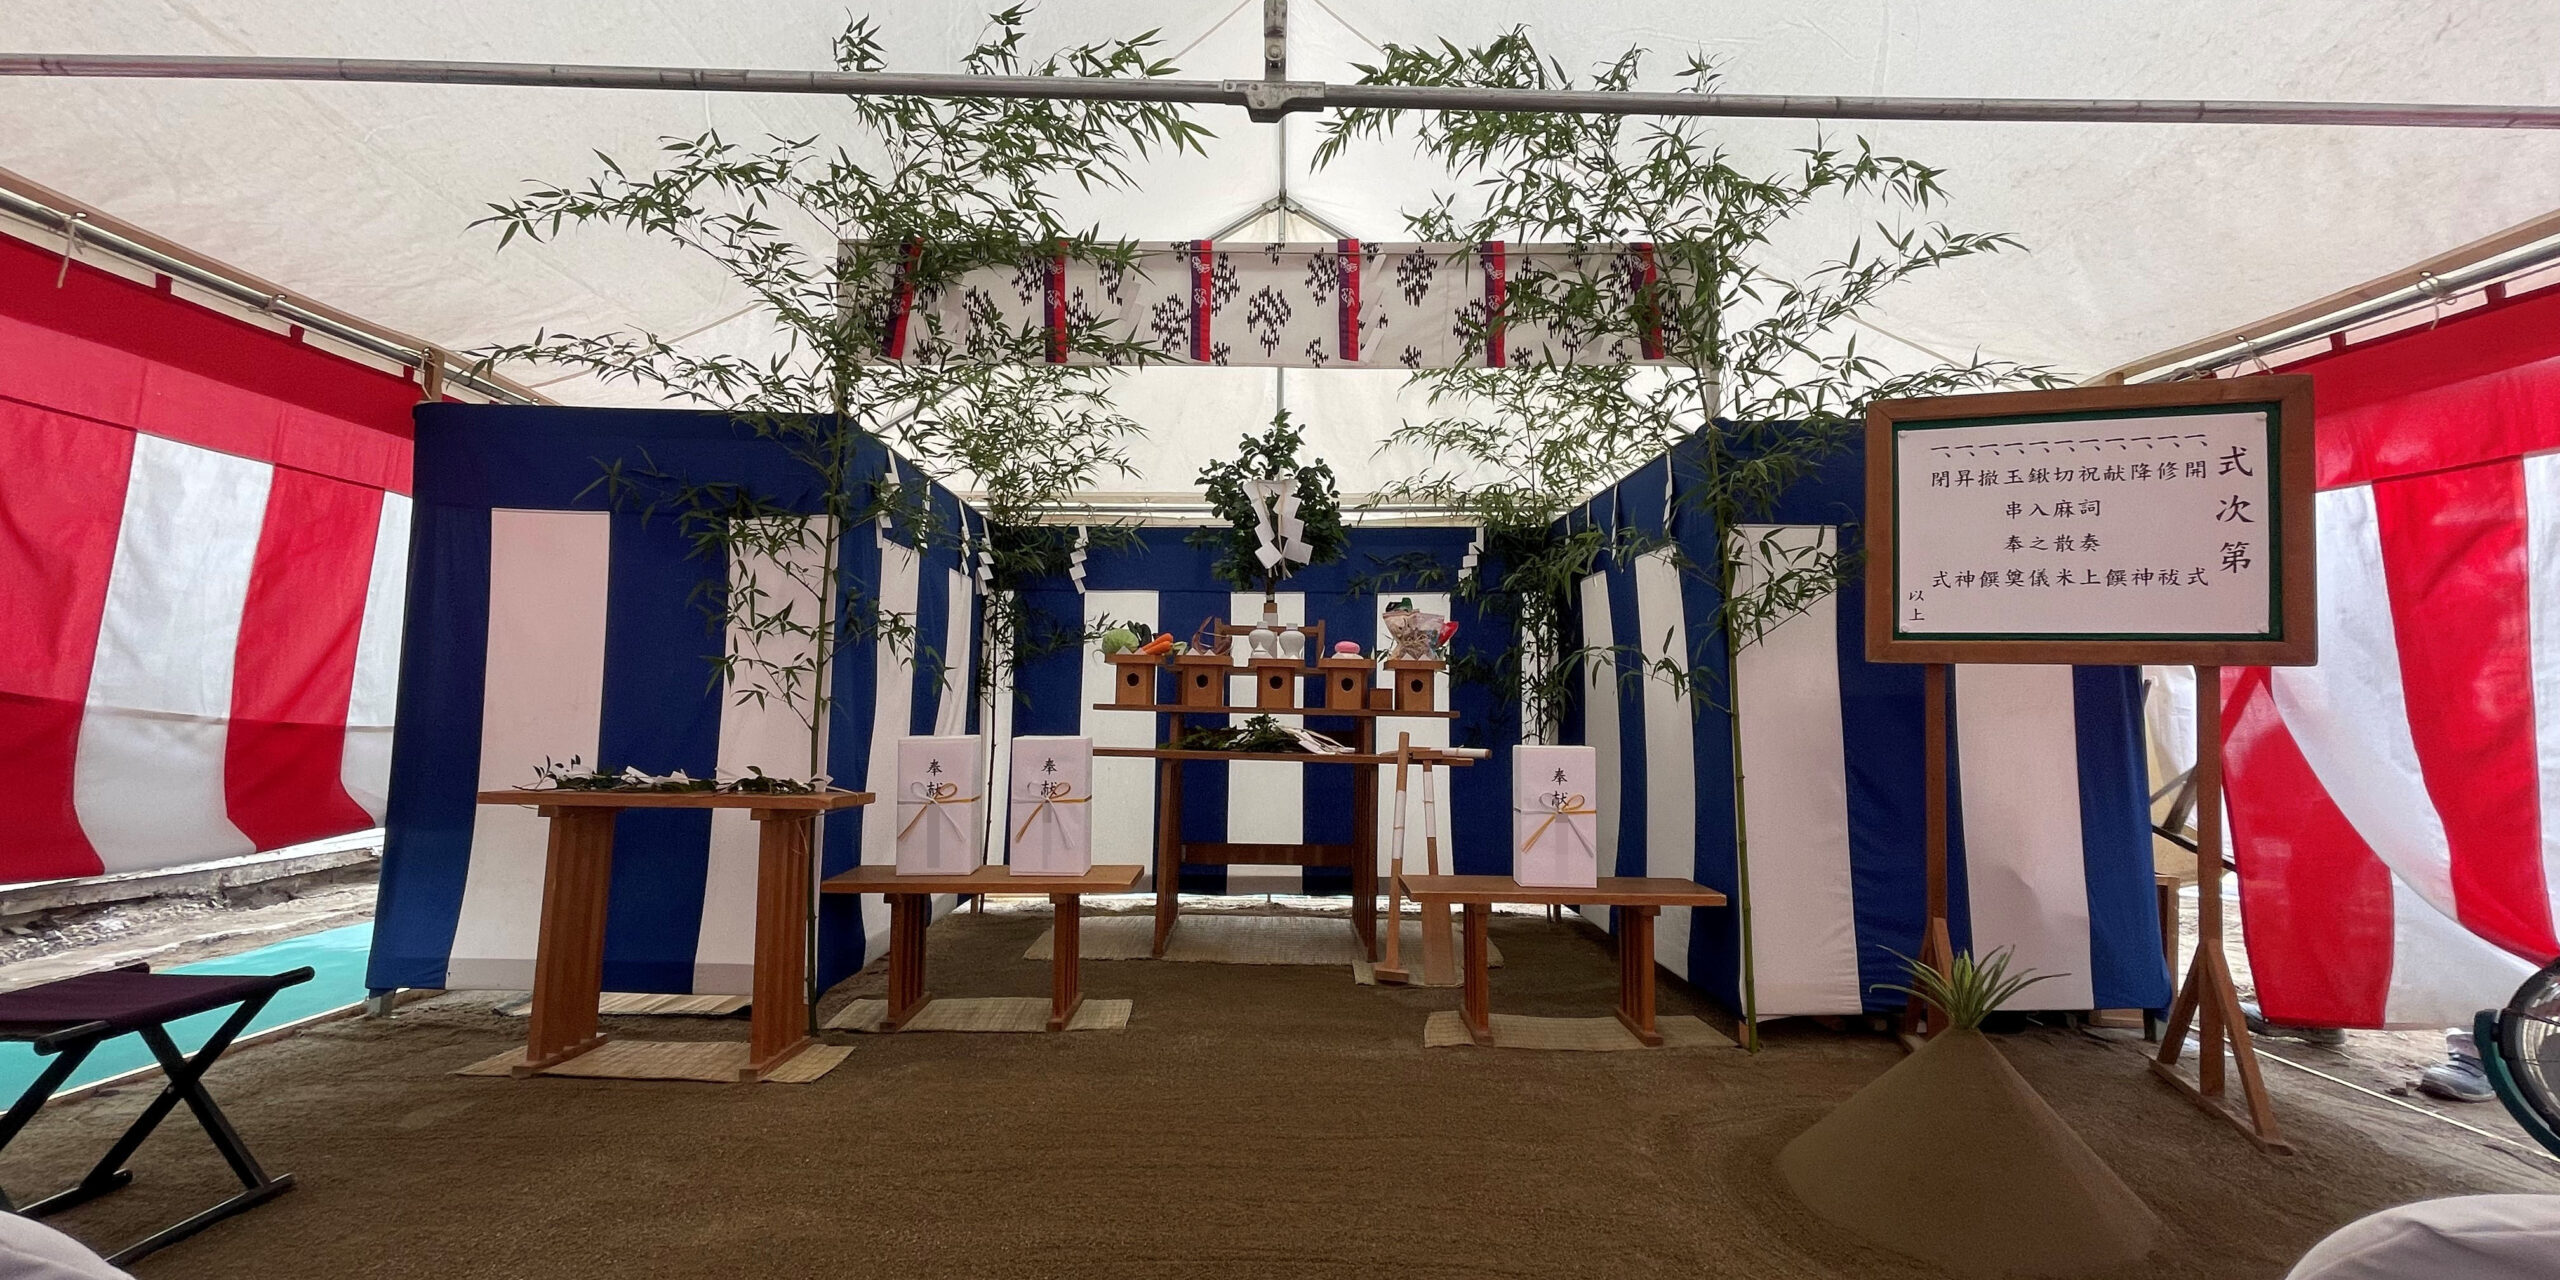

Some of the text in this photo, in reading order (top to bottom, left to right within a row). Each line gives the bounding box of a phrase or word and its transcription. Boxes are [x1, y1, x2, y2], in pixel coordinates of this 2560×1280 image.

[2214, 445, 2255, 574] 式次第
[1908, 590, 1926, 621] 以上
